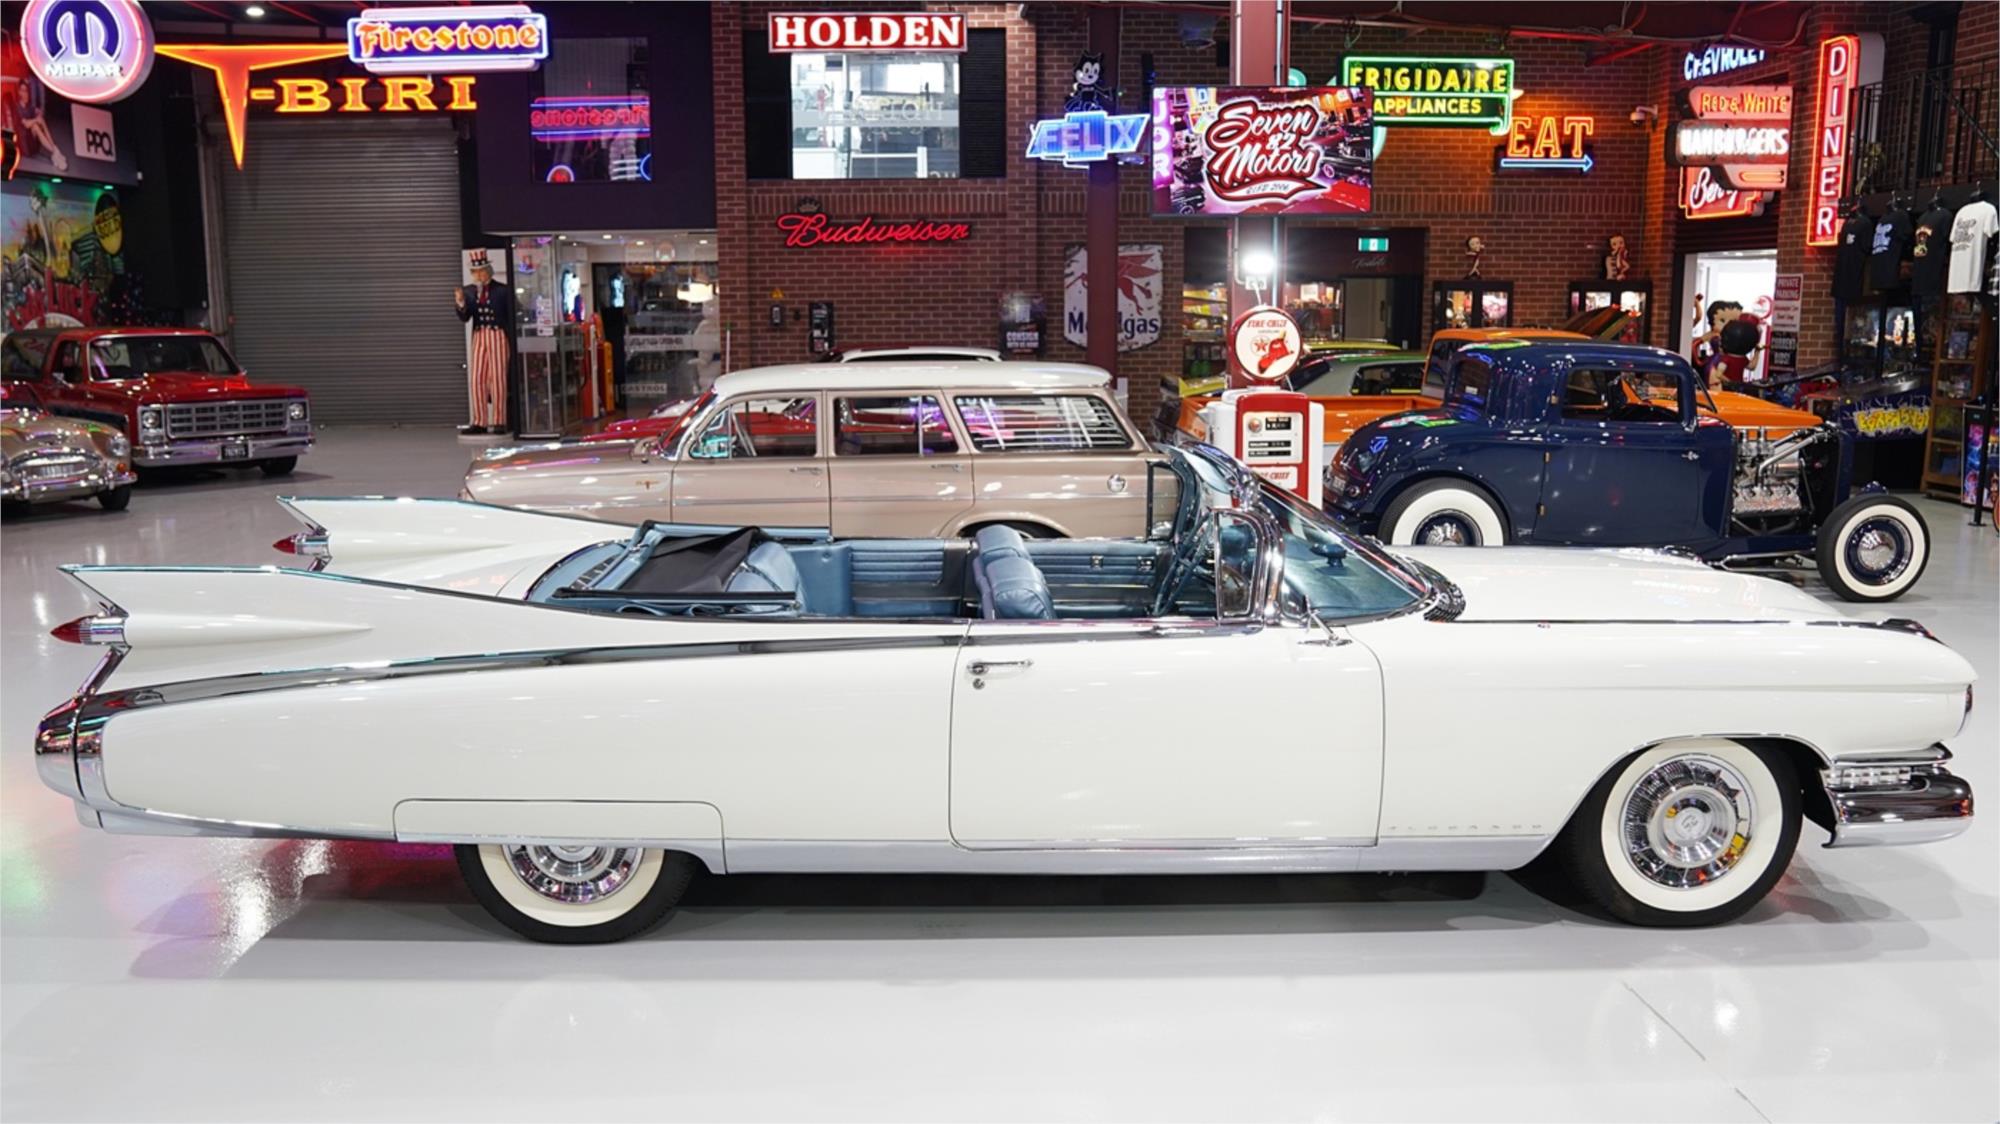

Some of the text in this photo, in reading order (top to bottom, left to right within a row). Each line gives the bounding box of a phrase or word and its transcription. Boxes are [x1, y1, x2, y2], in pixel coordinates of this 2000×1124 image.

[354, 21, 540, 57] Firestone
[774, 16, 961, 46] HOLDEN
[45, 63, 124, 77] MOPAR
[1350, 67, 1507, 92] FRIGIDAIRE
[1374, 98, 1482, 114] APPLIANCES
[1702, 93, 1730, 112] RED
[1743, 91, 1788, 113] WHITE
[1044, 119, 1136, 153] FELIX
[1210, 103, 1313, 147] Seven
[1507, 117, 1594, 158] EAT
[1265, 133, 1296, 150] 82
[1679, 128, 1789, 155] HAMBURGERS
[1816, 46, 1846, 236] DINER
[1212, 145, 1315, 185] Motors
[777, 213, 970, 247] Budweiser
[1067, 311, 1160, 340] Mlgas
